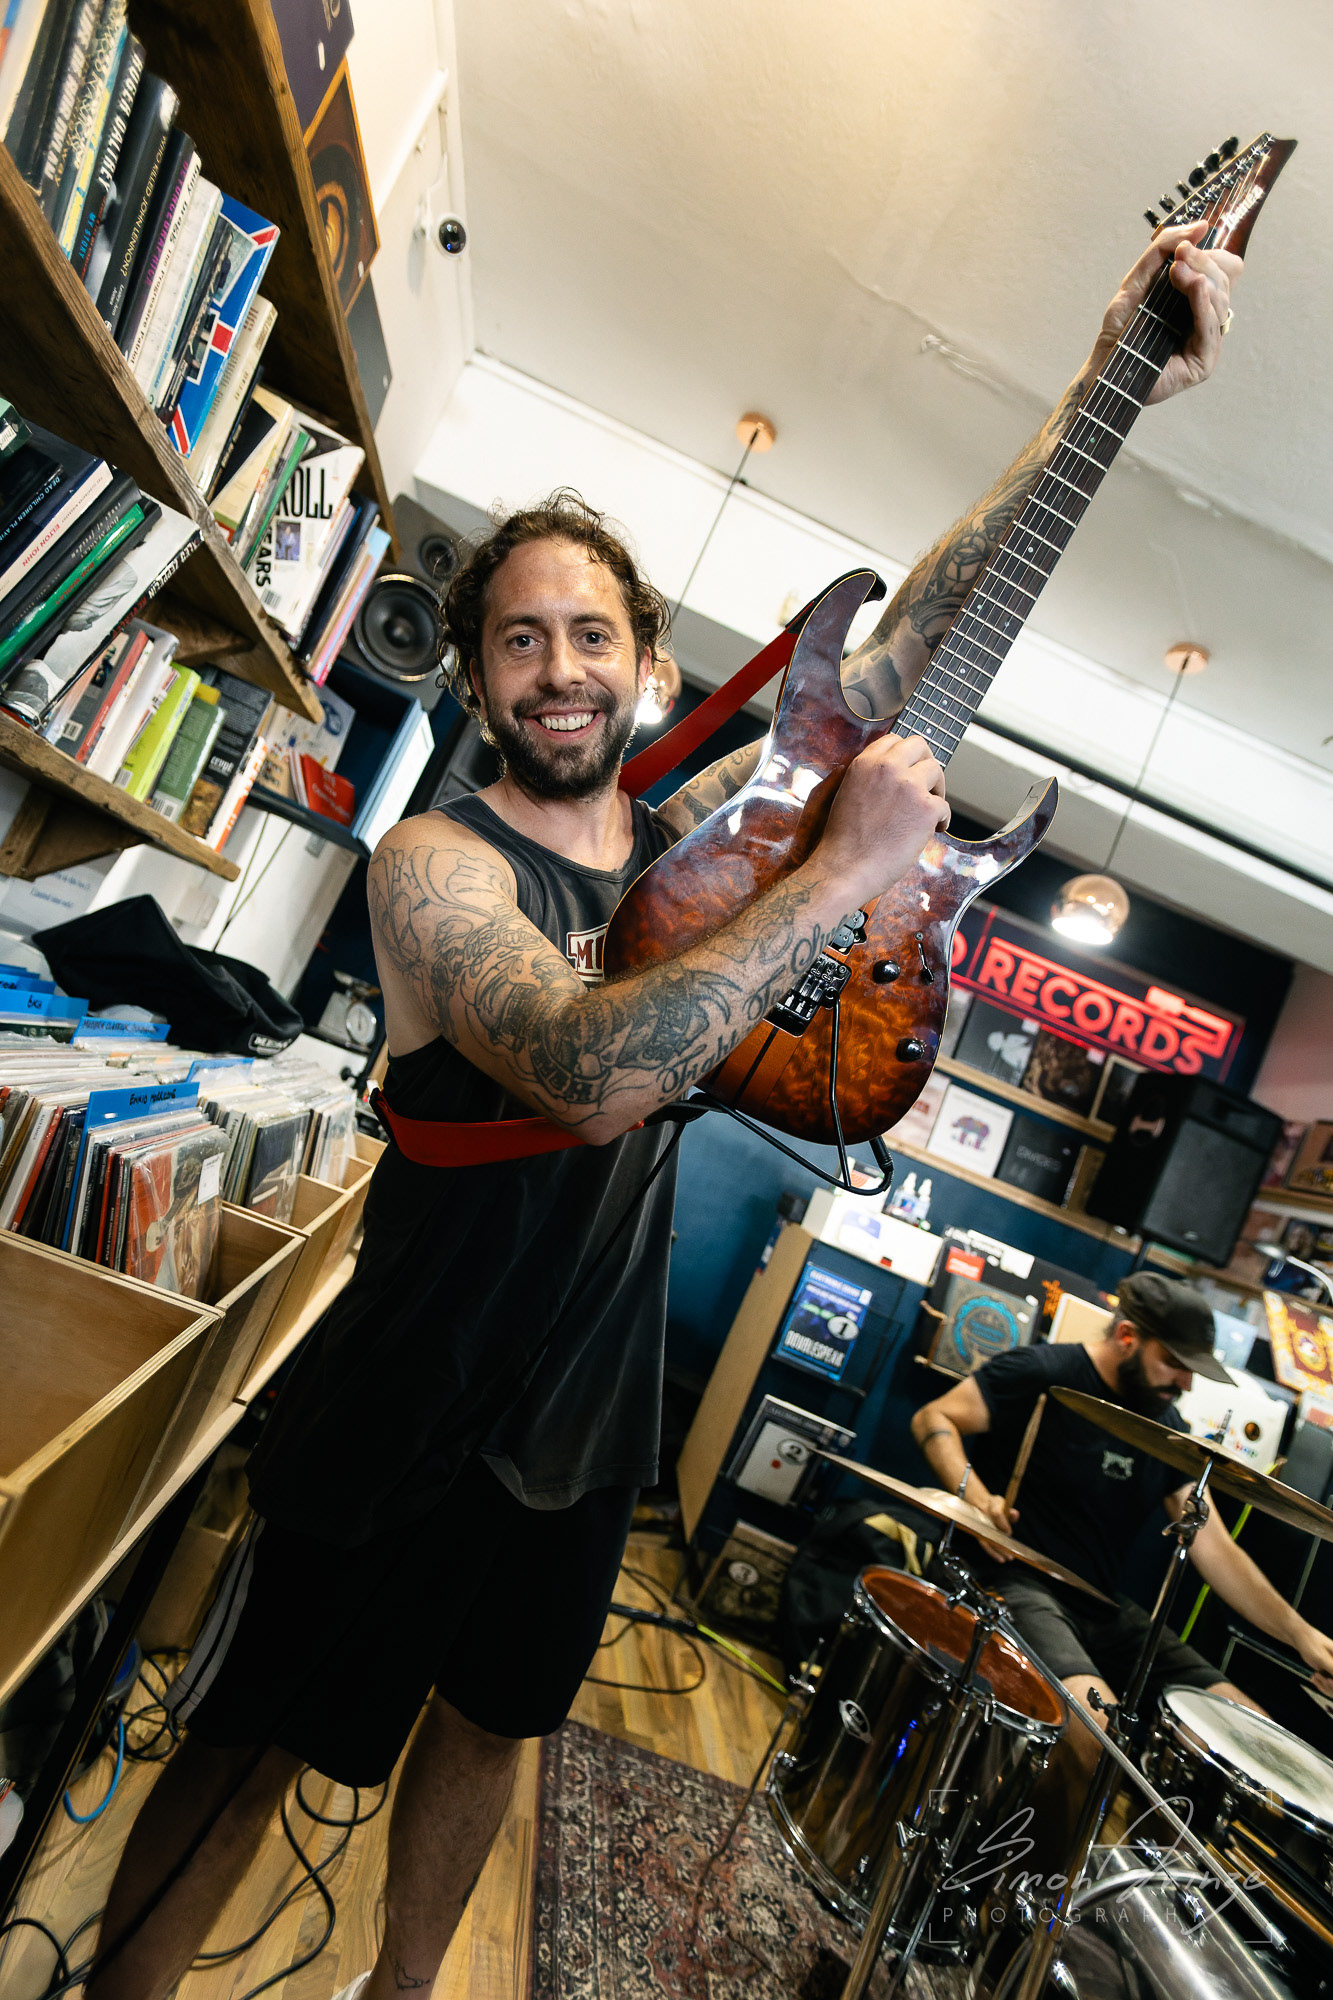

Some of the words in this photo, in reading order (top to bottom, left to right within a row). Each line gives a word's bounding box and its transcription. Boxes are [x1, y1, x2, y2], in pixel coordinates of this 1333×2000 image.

[119, 53, 143, 117] ROGER
[98, 114, 127, 193] DALTREY
[156, 136, 166, 161] WHO
[146, 162, 160, 197] KILLED
[88, 212, 96, 225] MY
[136, 196, 149, 227] JOHN
[1220, 184, 1265, 231] Ibanez
[79, 226, 94, 259] STORY
[122, 225, 142, 277] LENNON?
[143, 269, 164, 328] Progressive
[130, 331, 147, 364] Patriot
[46, 476, 61, 494] DEAD
[18, 492, 45, 522] CHILDREN
[40, 523, 60, 546] ELTON
[70, 528, 96, 559] freedom
[22, 547, 41, 567] JOHN
[81, 561, 95, 577] BOB
[55, 577, 81, 606] MARLEY
[147, 559, 180, 598] ZEPPELIN
[978, 944, 1203, 1075] RECORDS
[130, 1091, 148, 1105] ENNIO
